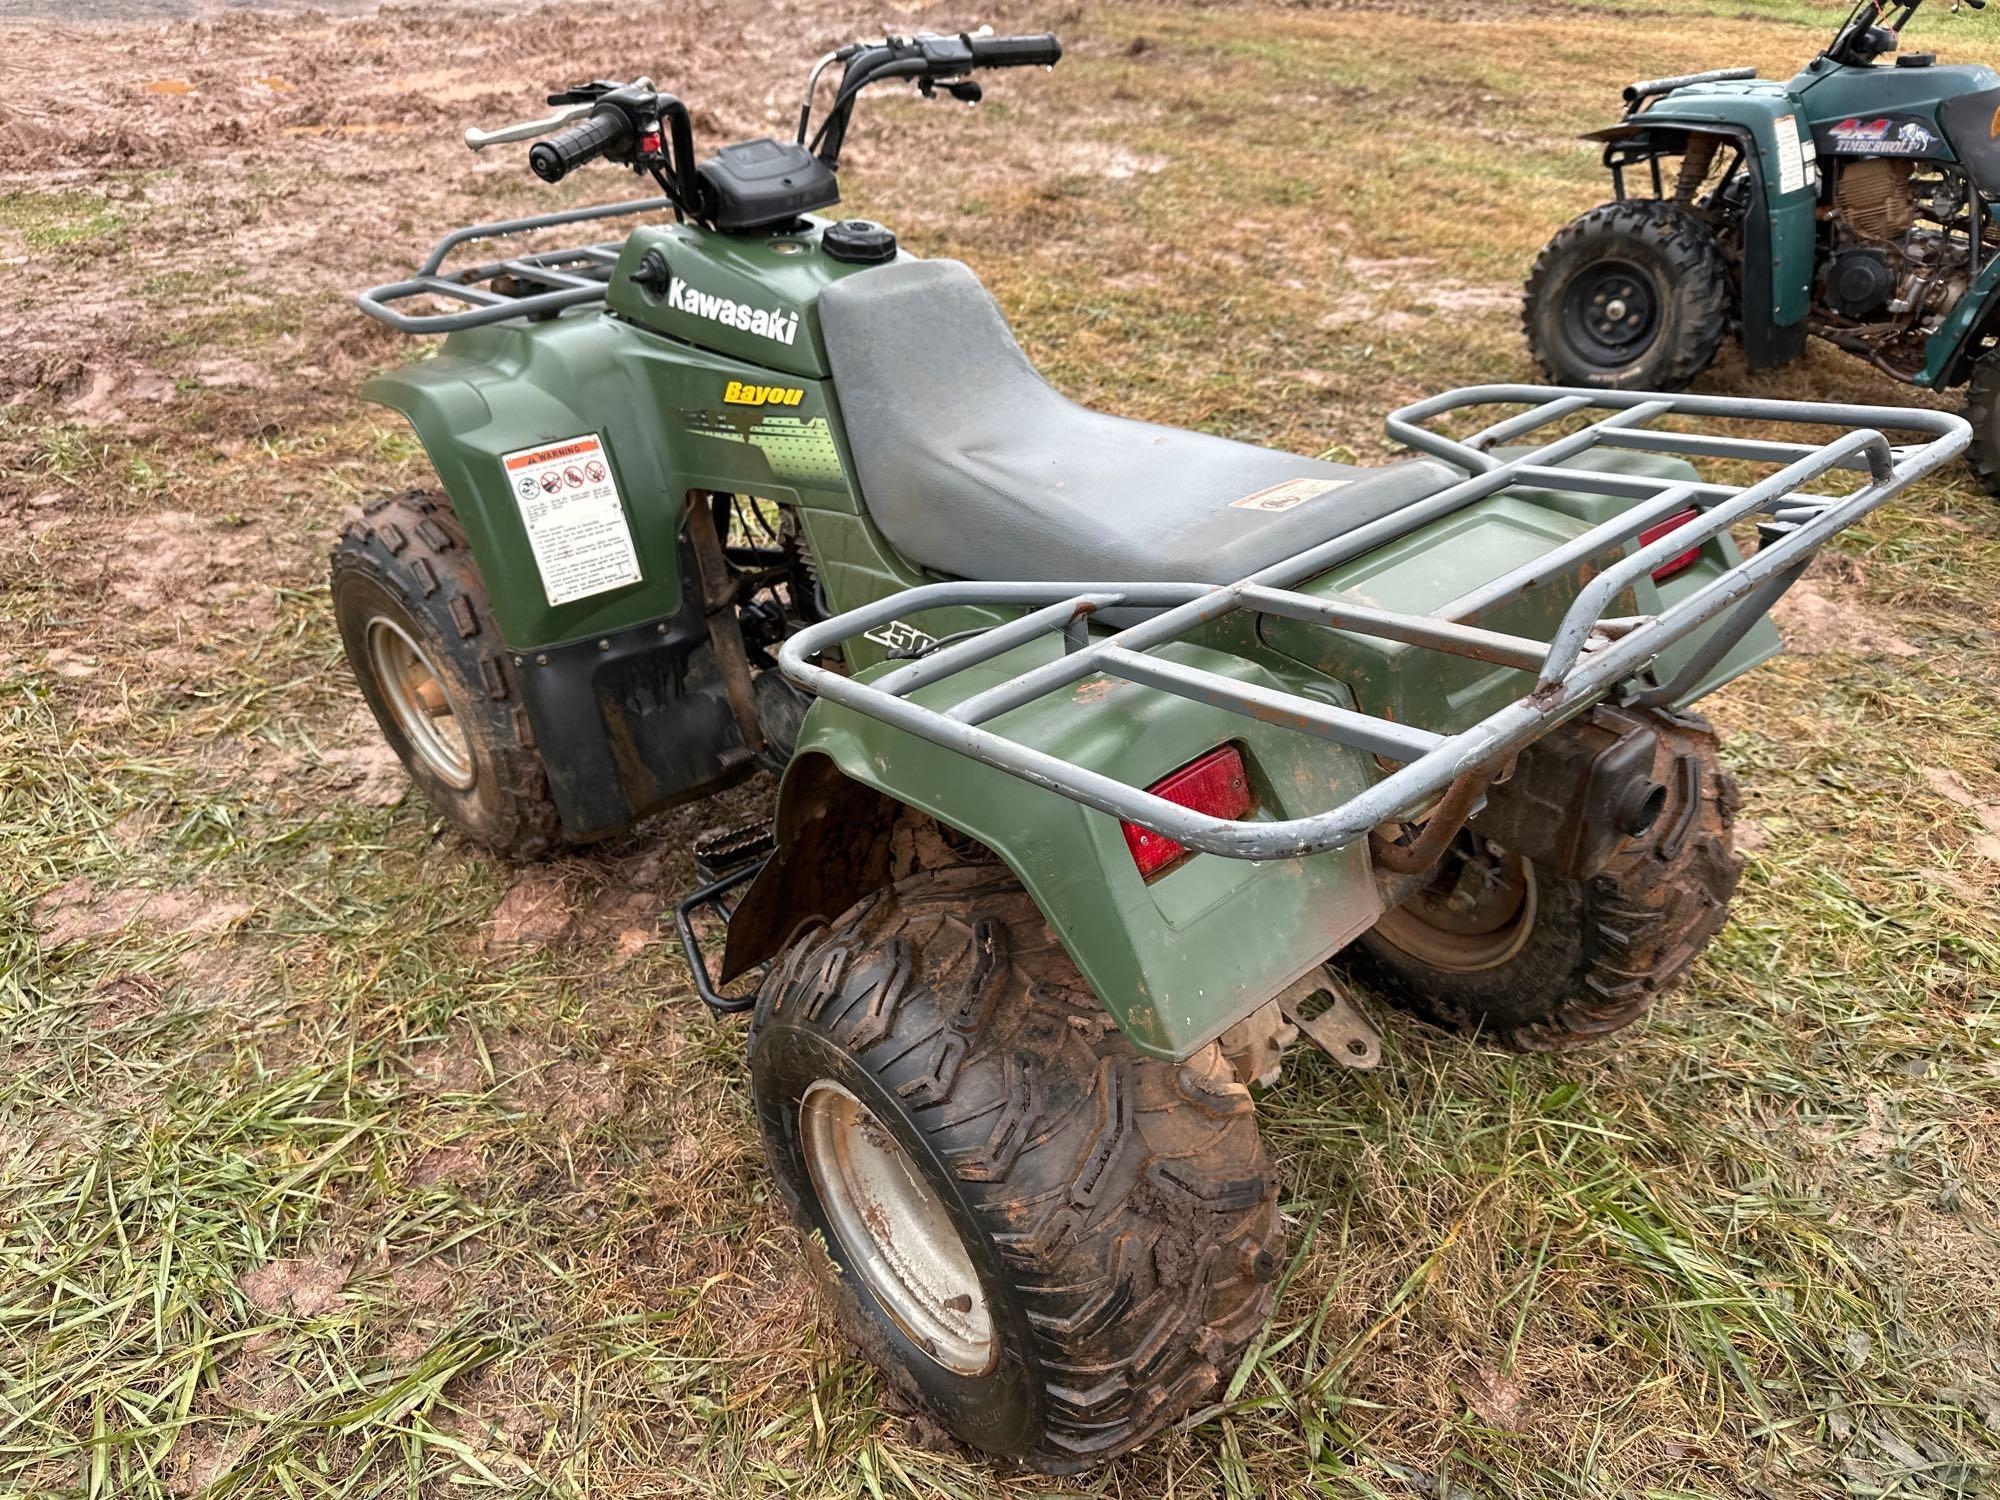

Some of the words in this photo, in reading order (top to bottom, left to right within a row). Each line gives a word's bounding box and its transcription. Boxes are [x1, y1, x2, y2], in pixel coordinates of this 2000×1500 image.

[1835, 140, 1914, 153] TIMBERWOLF
[668, 276, 799, 345] Kawasaki
[724, 381, 804, 406] Bayou
[538, 445, 581, 461] WARNING
